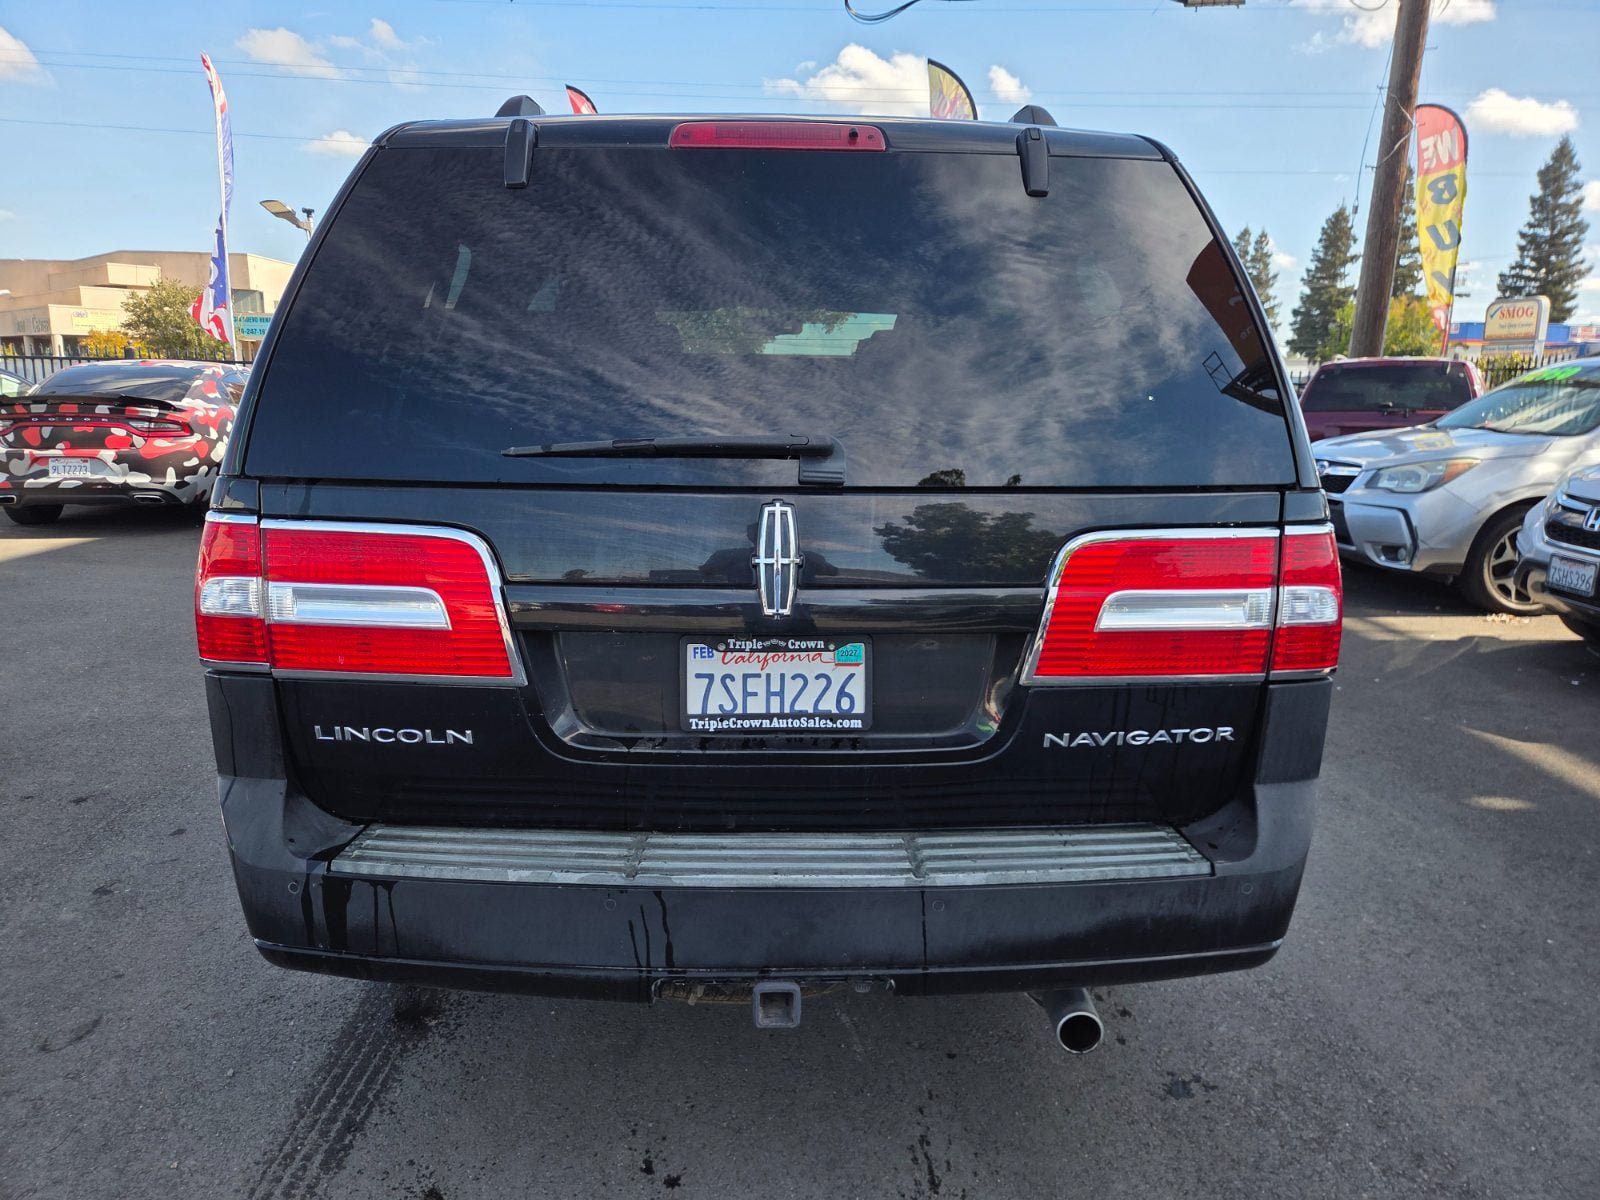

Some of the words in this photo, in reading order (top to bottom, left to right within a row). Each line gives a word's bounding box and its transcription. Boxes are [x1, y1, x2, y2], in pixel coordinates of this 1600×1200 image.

[1499, 305, 1534, 319] SMOG
[1551, 565, 1593, 591] 7SHS396
[692, 646, 715, 659] FEB
[728, 638, 762, 651] Triple
[788, 639, 824, 649] Crown
[840, 649, 857, 657] 2027
[721, 651, 834, 671] California
[694, 672, 856, 714] 7SFH226
[689, 717, 863, 731] TripleCrownAutoSales.com
[314, 725, 473, 745] LINCOLN
[1043, 726, 1235, 748] NAVIGATOR
